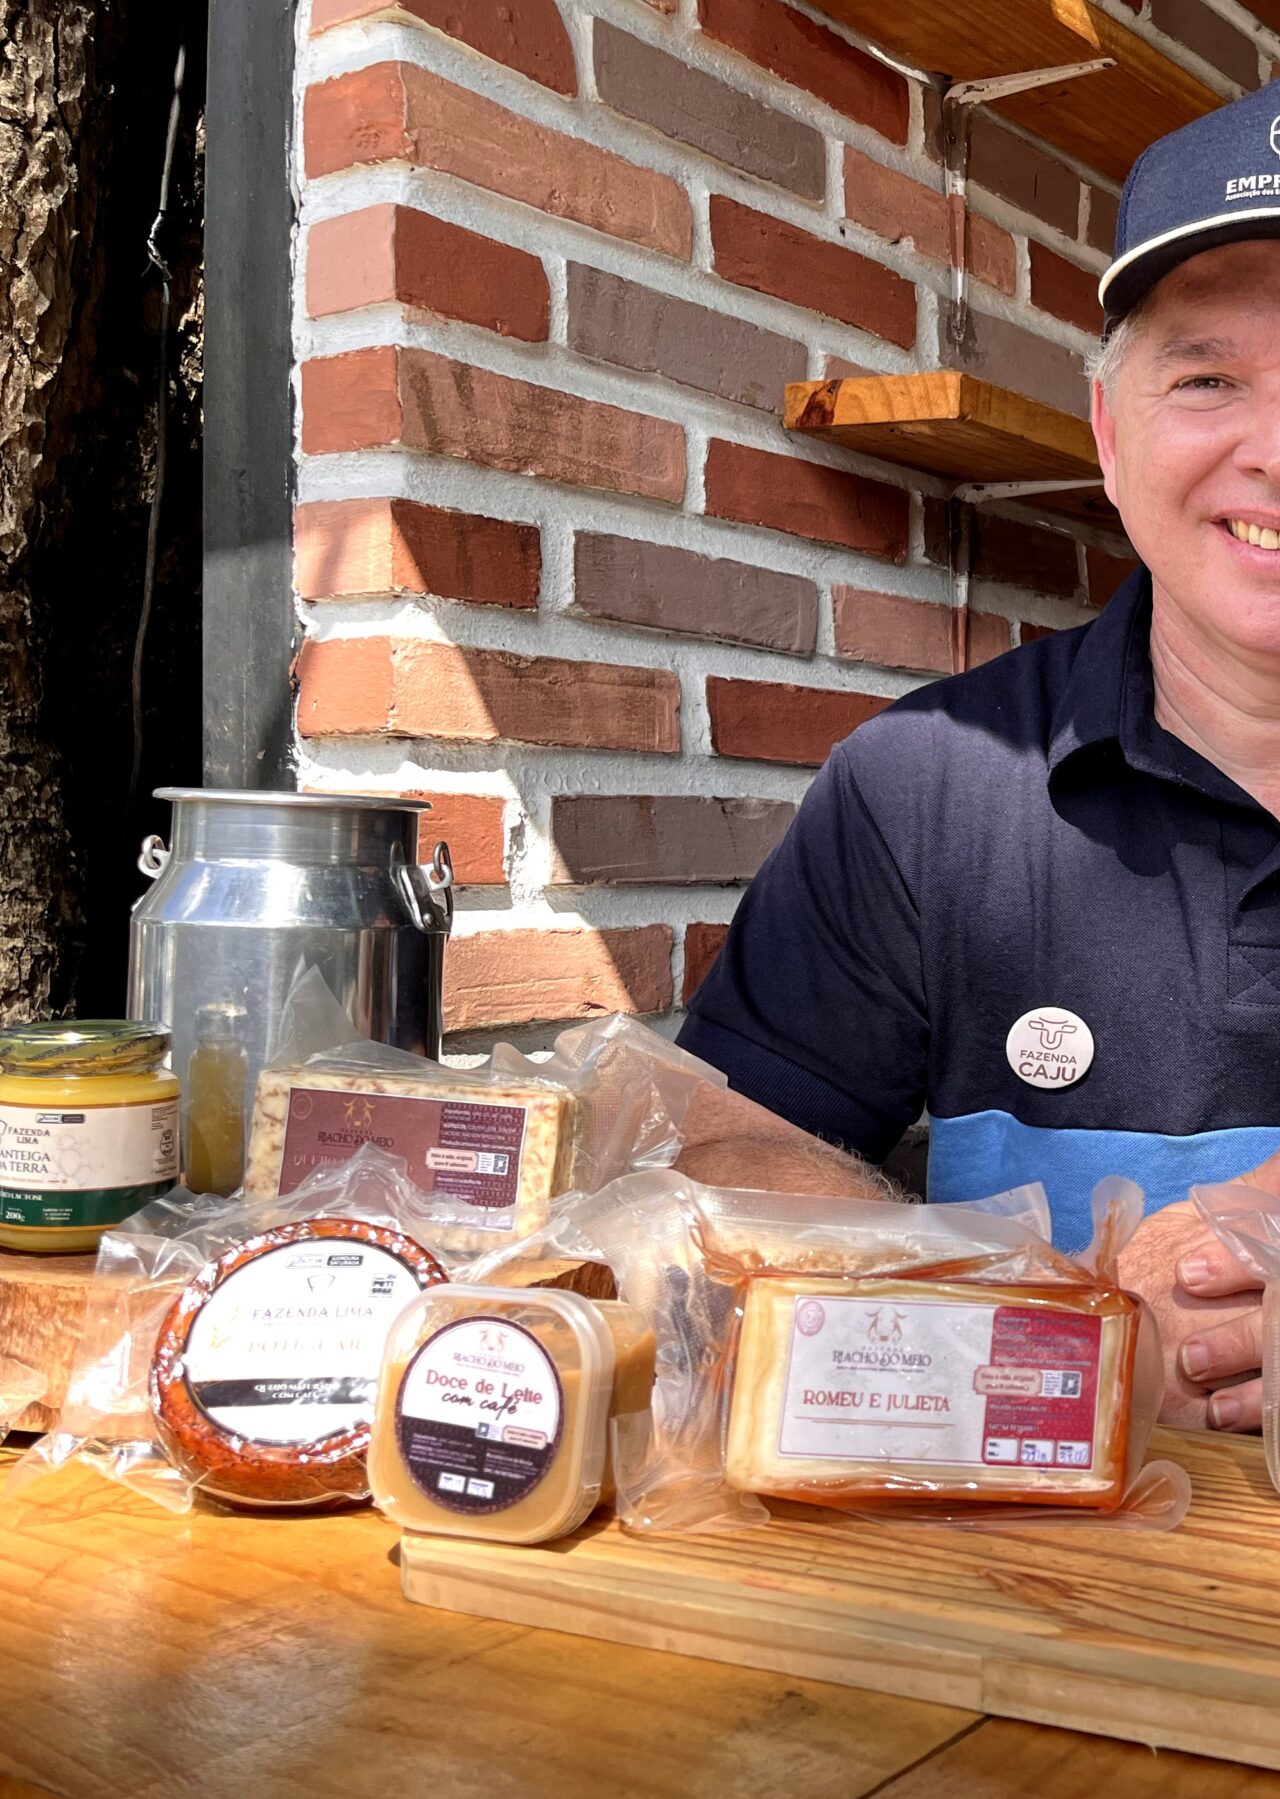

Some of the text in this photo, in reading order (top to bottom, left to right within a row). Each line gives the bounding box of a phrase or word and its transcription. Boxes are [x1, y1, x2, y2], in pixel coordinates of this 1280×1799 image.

[1020, 1050, 1077, 1064] FAZENDA
[1019, 1061, 1077, 1082] CAJU
[8, 1127, 51, 1137] FAZENDA
[17, 1136, 39, 1144] LIMA
[10, 1162, 49, 1174] TERRA
[252, 1308, 328, 1319] FAZENDA
[832, 1350, 932, 1367] RIACHO DO MEIO
[426, 1369, 468, 1390] Doce
[475, 1378, 495, 1395] de
[501, 1382, 543, 1404] Leite
[441, 1392, 519, 1421] com café
[803, 1389, 951, 1412] ROMEU E JULIETA
